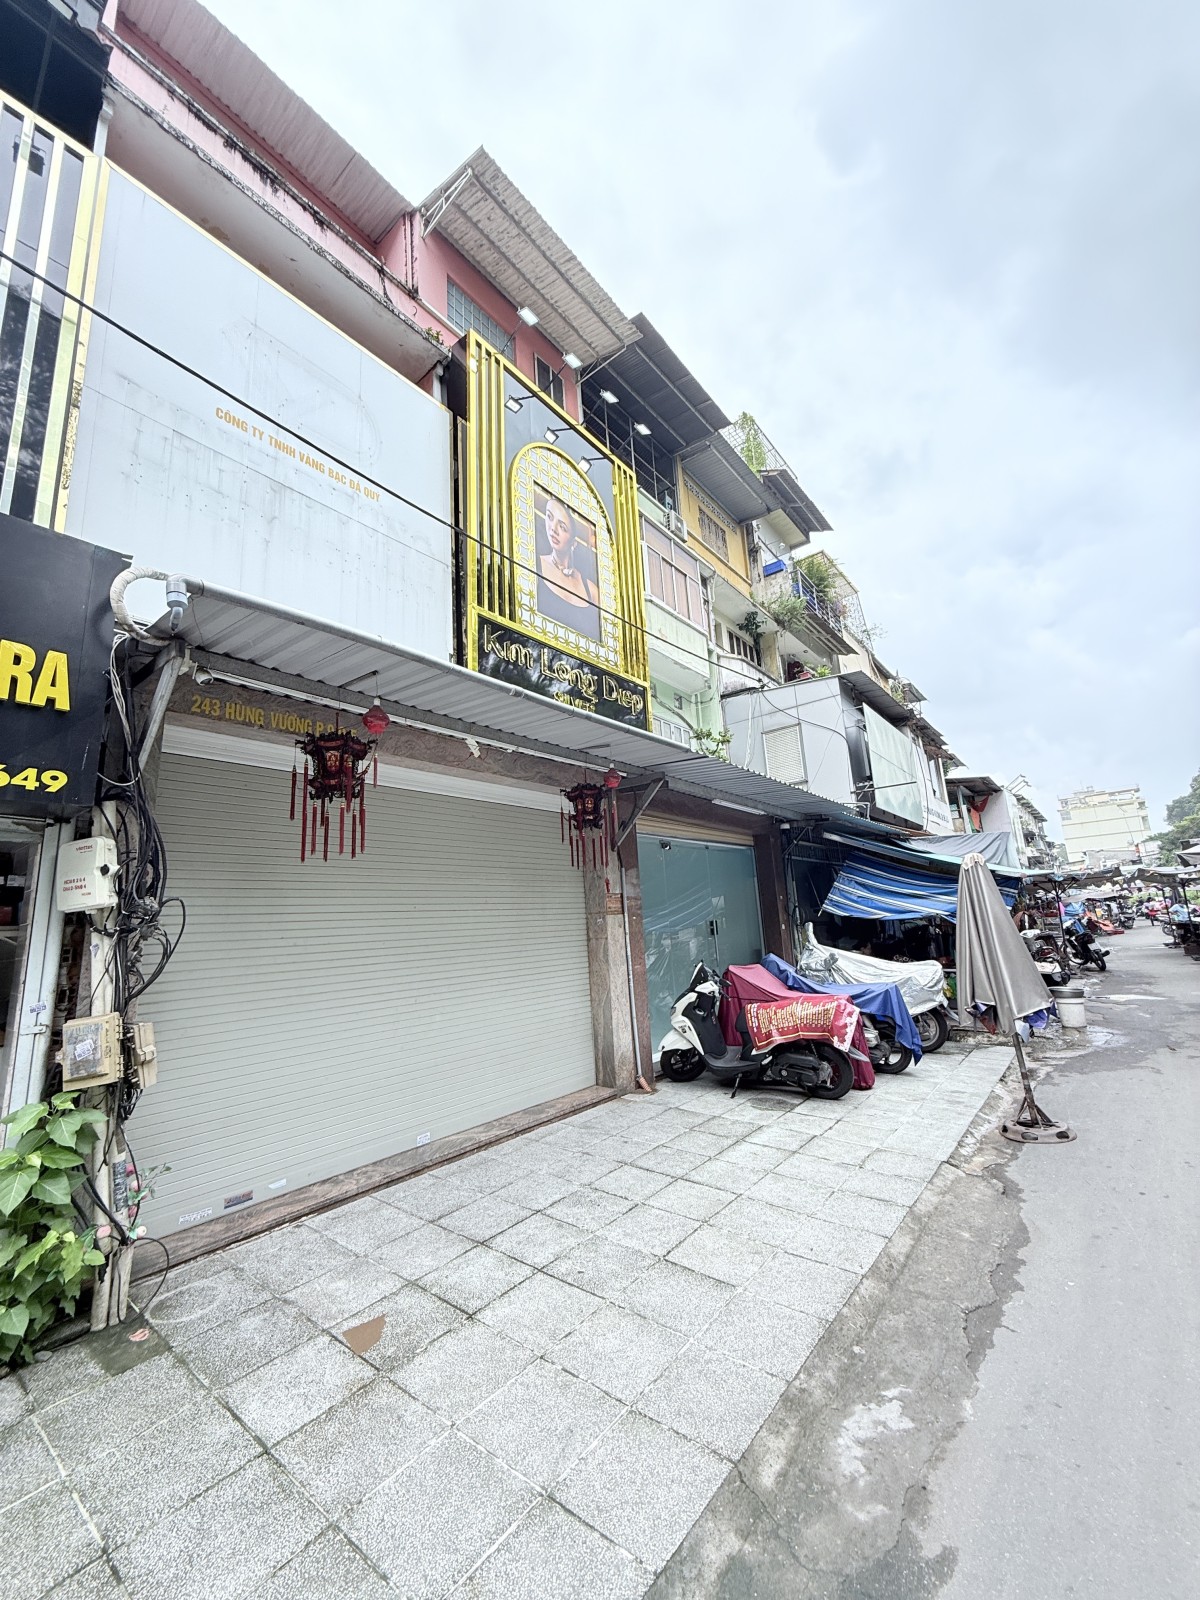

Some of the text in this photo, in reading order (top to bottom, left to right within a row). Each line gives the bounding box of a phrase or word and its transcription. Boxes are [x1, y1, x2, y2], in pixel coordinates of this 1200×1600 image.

[215, 407, 248, 433] CÔNG
[251, 425, 265, 441] TY
[268, 434, 296, 458] TNHH
[299, 450, 326, 474] VÀNG
[328, 467, 347, 485] BẠC
[0, 639, 71, 712] RA
[483, 624, 534, 669] Kim
[540, 647, 599, 704] Long
[191, 694, 221, 717] 243
[225, 702, 265, 725] HÙNG
[270, 711, 313, 733] VƯƠNG
